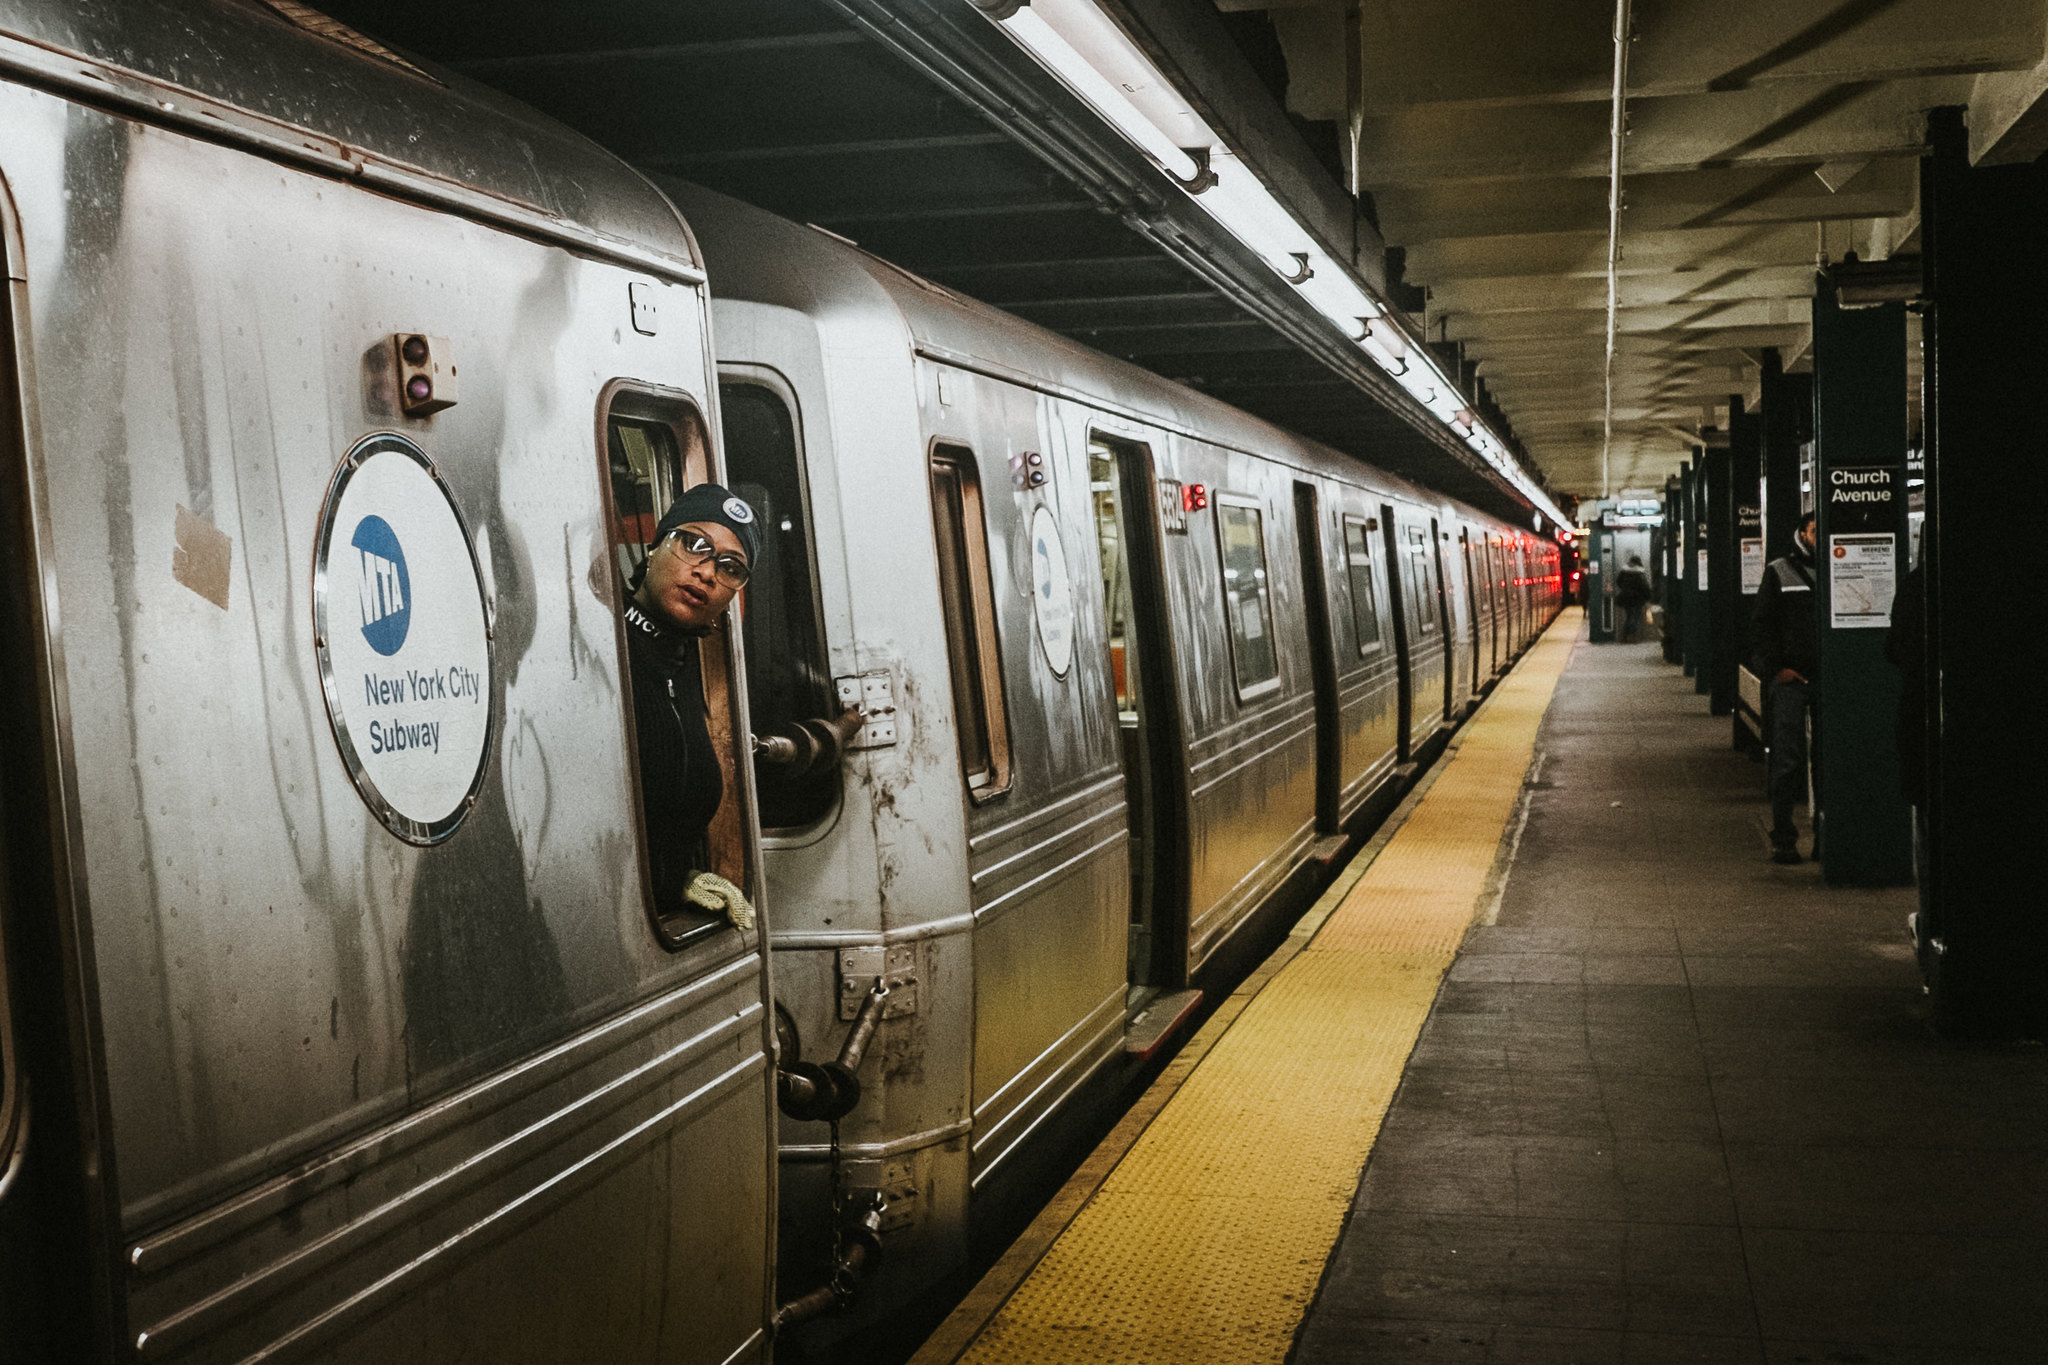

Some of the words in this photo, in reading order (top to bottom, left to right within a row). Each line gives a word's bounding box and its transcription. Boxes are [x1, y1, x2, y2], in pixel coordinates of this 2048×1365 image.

[1831, 469, 1890, 485] Church
[1832, 488, 1891, 502] Avenue
[352, 545, 405, 627] MTA
[624, 606, 660, 637] NYC
[365, 673, 404, 706] New
[407, 668, 446, 702] York
[449, 666, 480, 704] City
[369, 718, 440, 754] Subway
